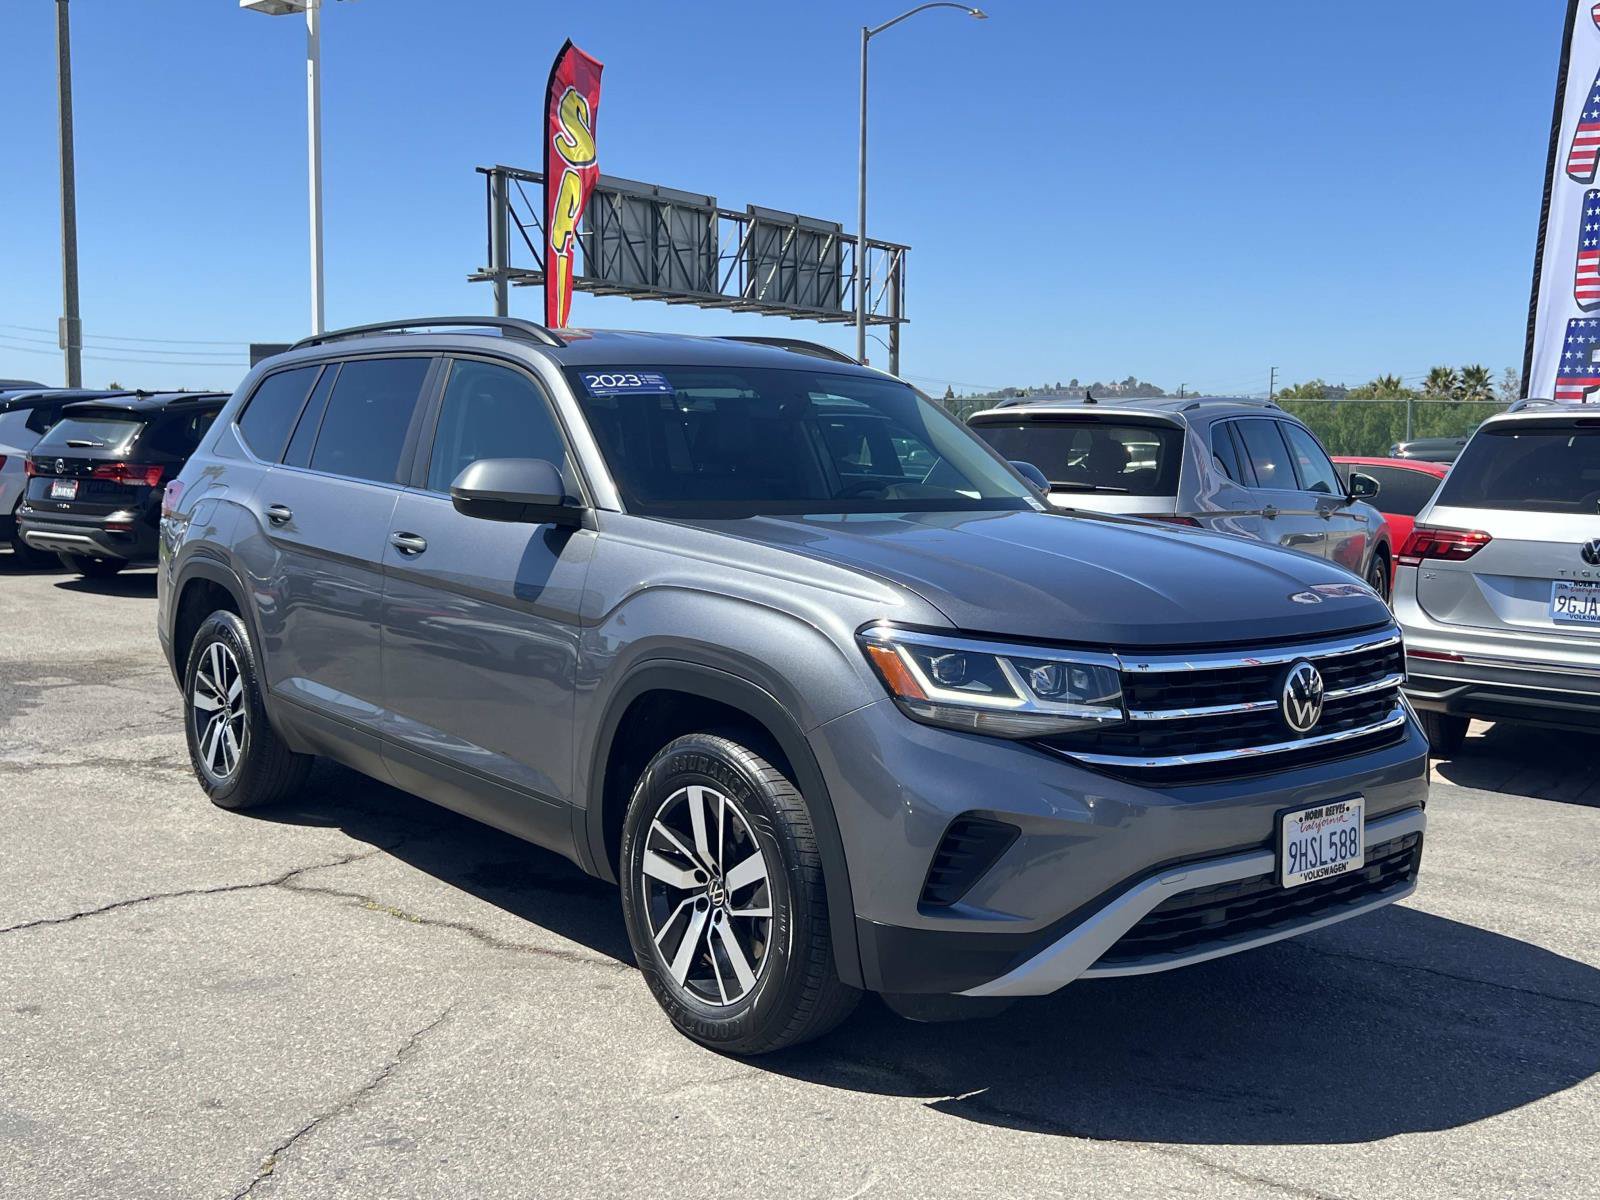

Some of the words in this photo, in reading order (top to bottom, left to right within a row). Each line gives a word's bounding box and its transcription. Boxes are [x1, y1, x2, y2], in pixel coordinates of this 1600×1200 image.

[585, 374, 642, 387] 2023
[1557, 595, 1597, 615] 9GJA
[1304, 808, 1323, 821] NORM
[1325, 803, 1346, 816] REEVES
[1300, 815, 1349, 833] California
[1289, 827, 1357, 874] 9HSL588
